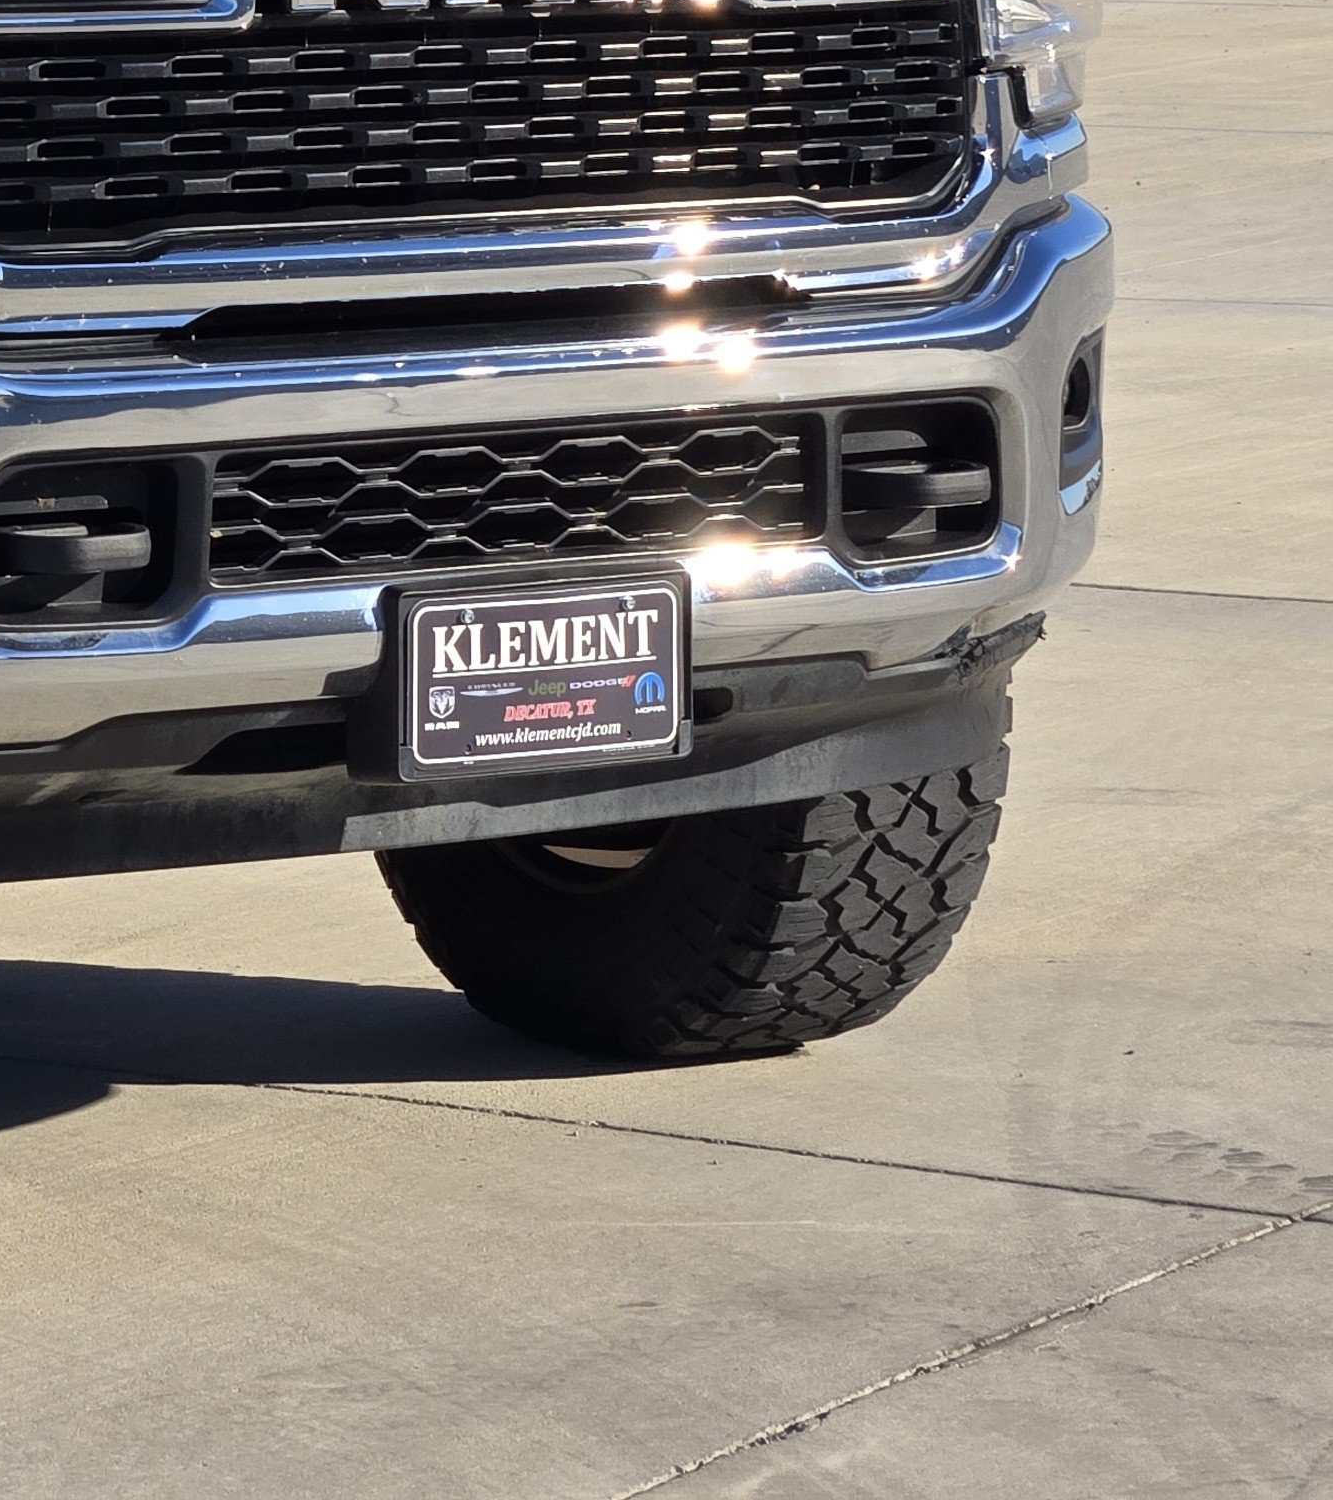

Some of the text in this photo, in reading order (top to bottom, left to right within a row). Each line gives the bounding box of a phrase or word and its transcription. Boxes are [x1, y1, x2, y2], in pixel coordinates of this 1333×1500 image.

[432, 609, 659, 673] KLEMENT
[527, 679, 567, 698] Jeep
[569, 677, 626, 690] DODGE
[503, 698, 597, 722] DECATUR, TX
[424, 720, 460, 731] RAM
[474, 721, 622, 747] www.klementcjd.com
